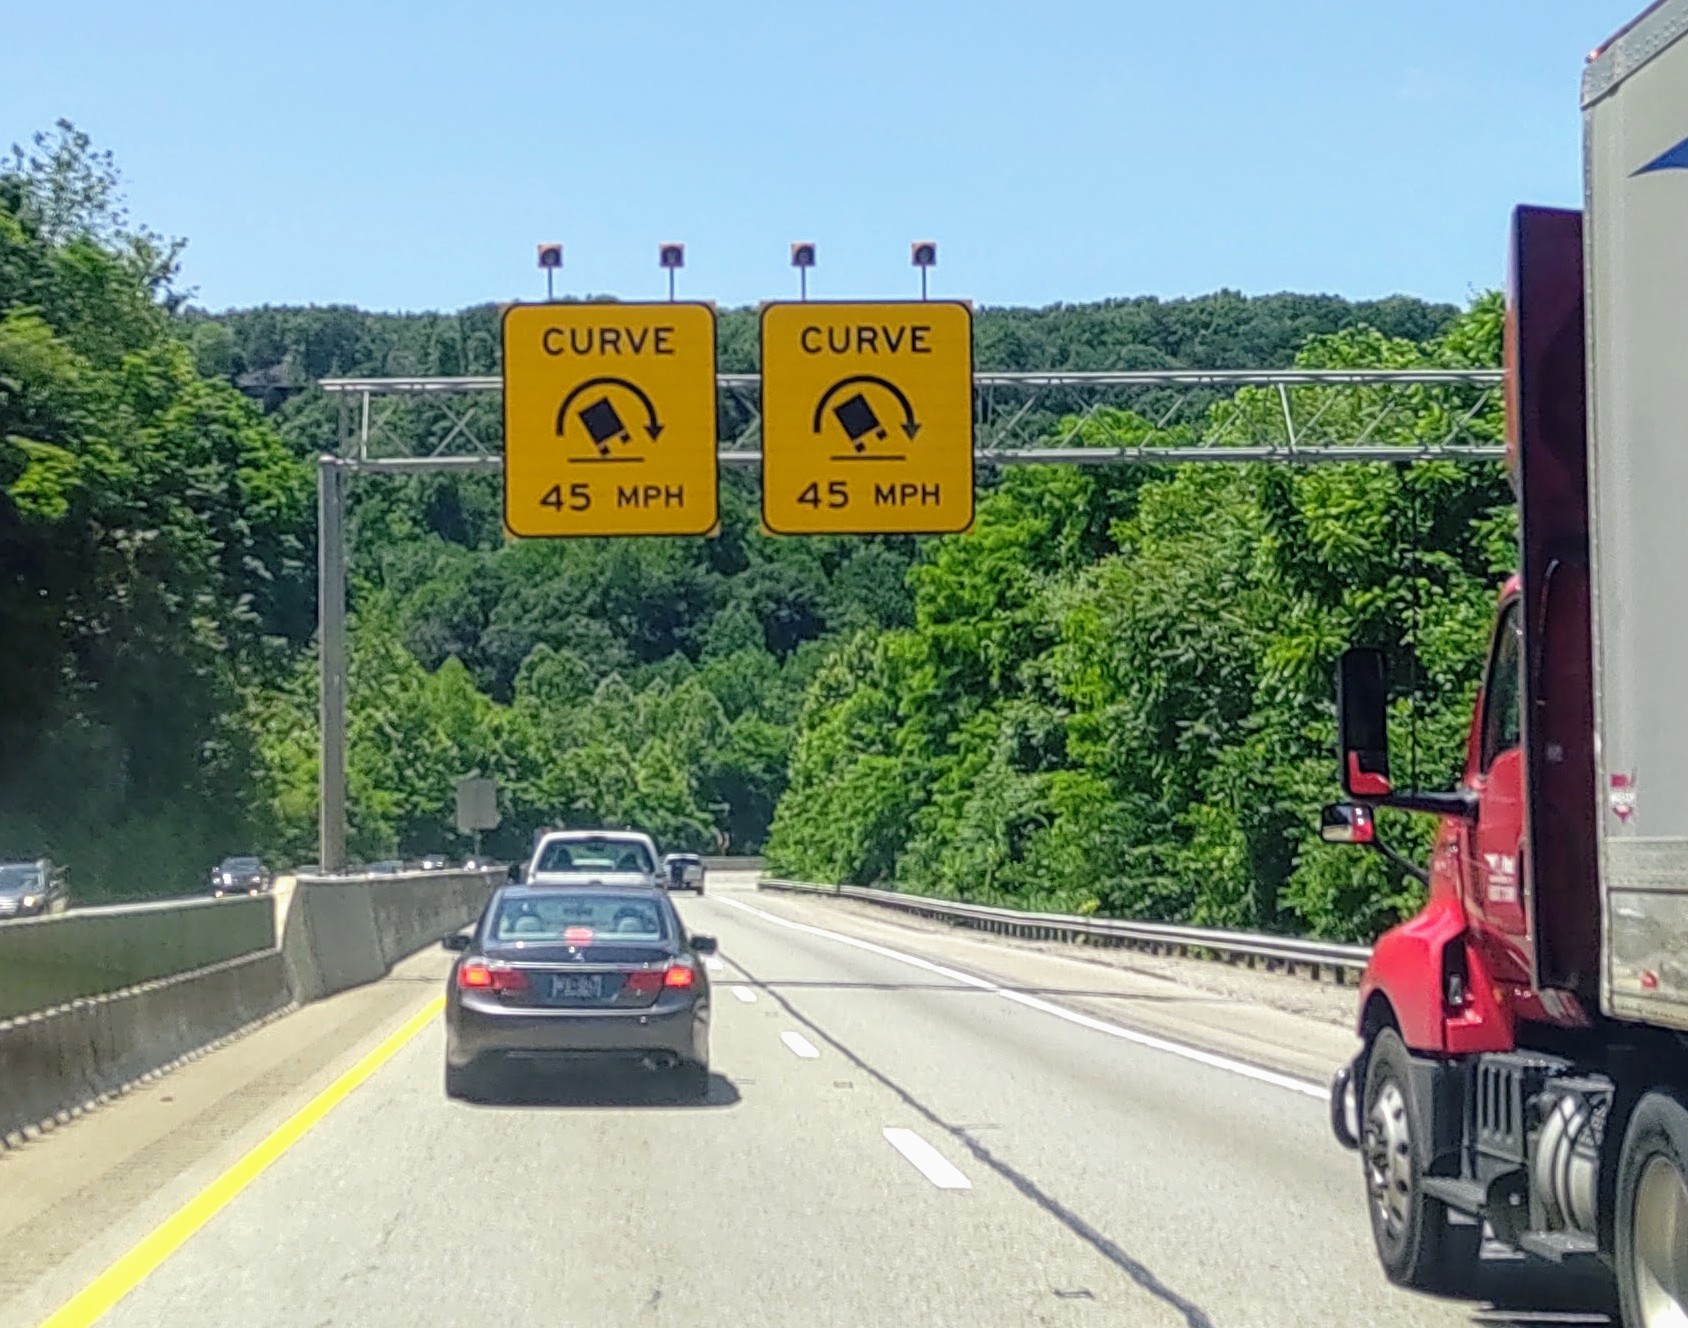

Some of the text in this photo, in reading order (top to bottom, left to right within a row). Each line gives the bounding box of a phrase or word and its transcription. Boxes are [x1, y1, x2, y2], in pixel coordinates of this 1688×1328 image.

[543, 327, 675, 355] CURVE
[801, 326, 932, 354] CURVE
[540, 484, 684, 512] 45 MPH
[797, 482, 940, 509] 45 MPH
